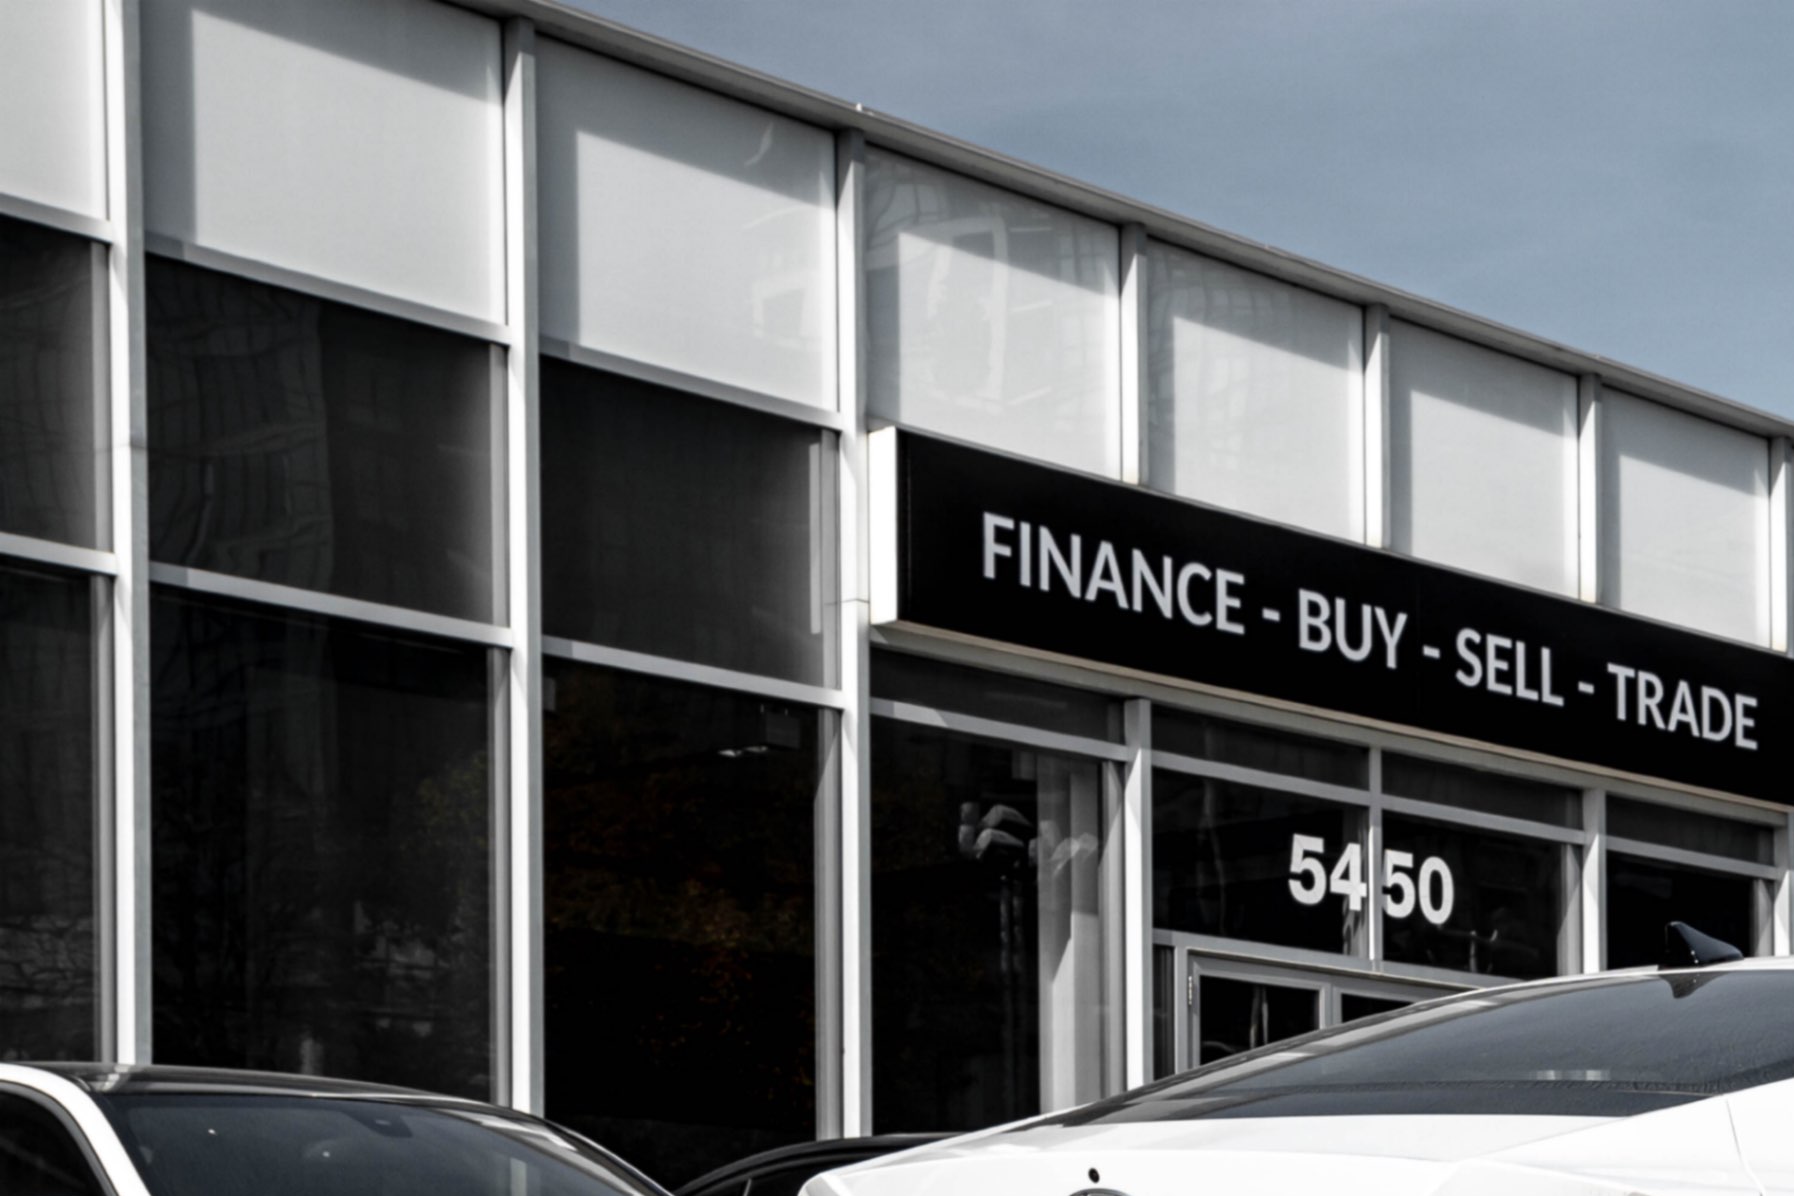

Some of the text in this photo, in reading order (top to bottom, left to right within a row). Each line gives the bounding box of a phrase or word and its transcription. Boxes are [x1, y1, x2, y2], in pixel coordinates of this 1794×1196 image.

[982, 511, 1246, 635] FINANCE
[1298, 588, 1408, 669] BUY
[1455, 627, 1564, 707] SELL
[1607, 662, 1758, 750] TRADE
[1288, 832, 1454, 925] 5450
